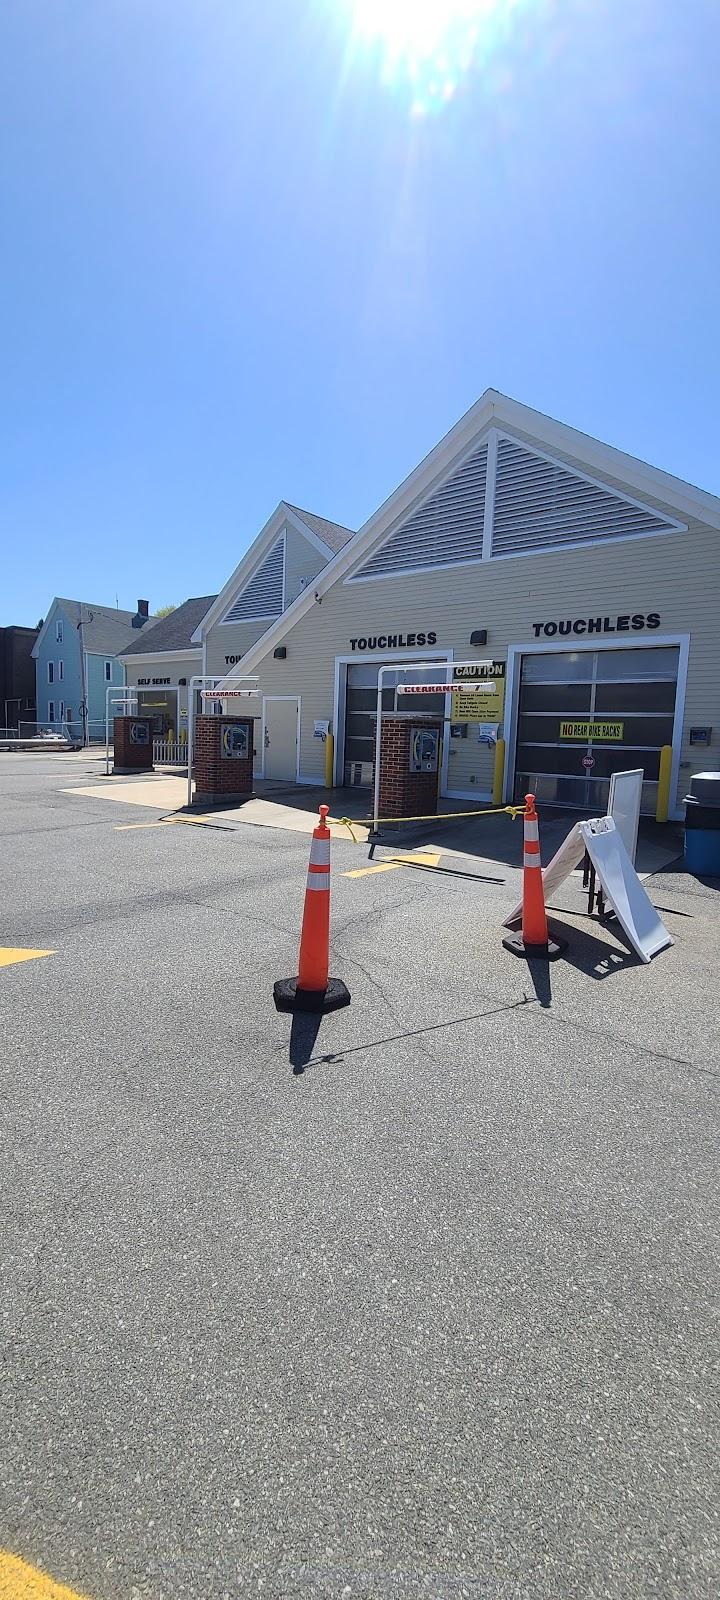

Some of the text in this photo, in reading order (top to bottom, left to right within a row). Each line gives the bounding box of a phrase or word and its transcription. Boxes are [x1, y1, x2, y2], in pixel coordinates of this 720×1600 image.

[533, 613, 660, 637] TOUCHLESS
[350, 632, 437, 651] TOUCHLESS
[455, 664, 503, 676] CAUTION
[404, 685, 464, 693] CLEARANCE
[562, 724, 621, 737] NO REAR BIKE RACKS
